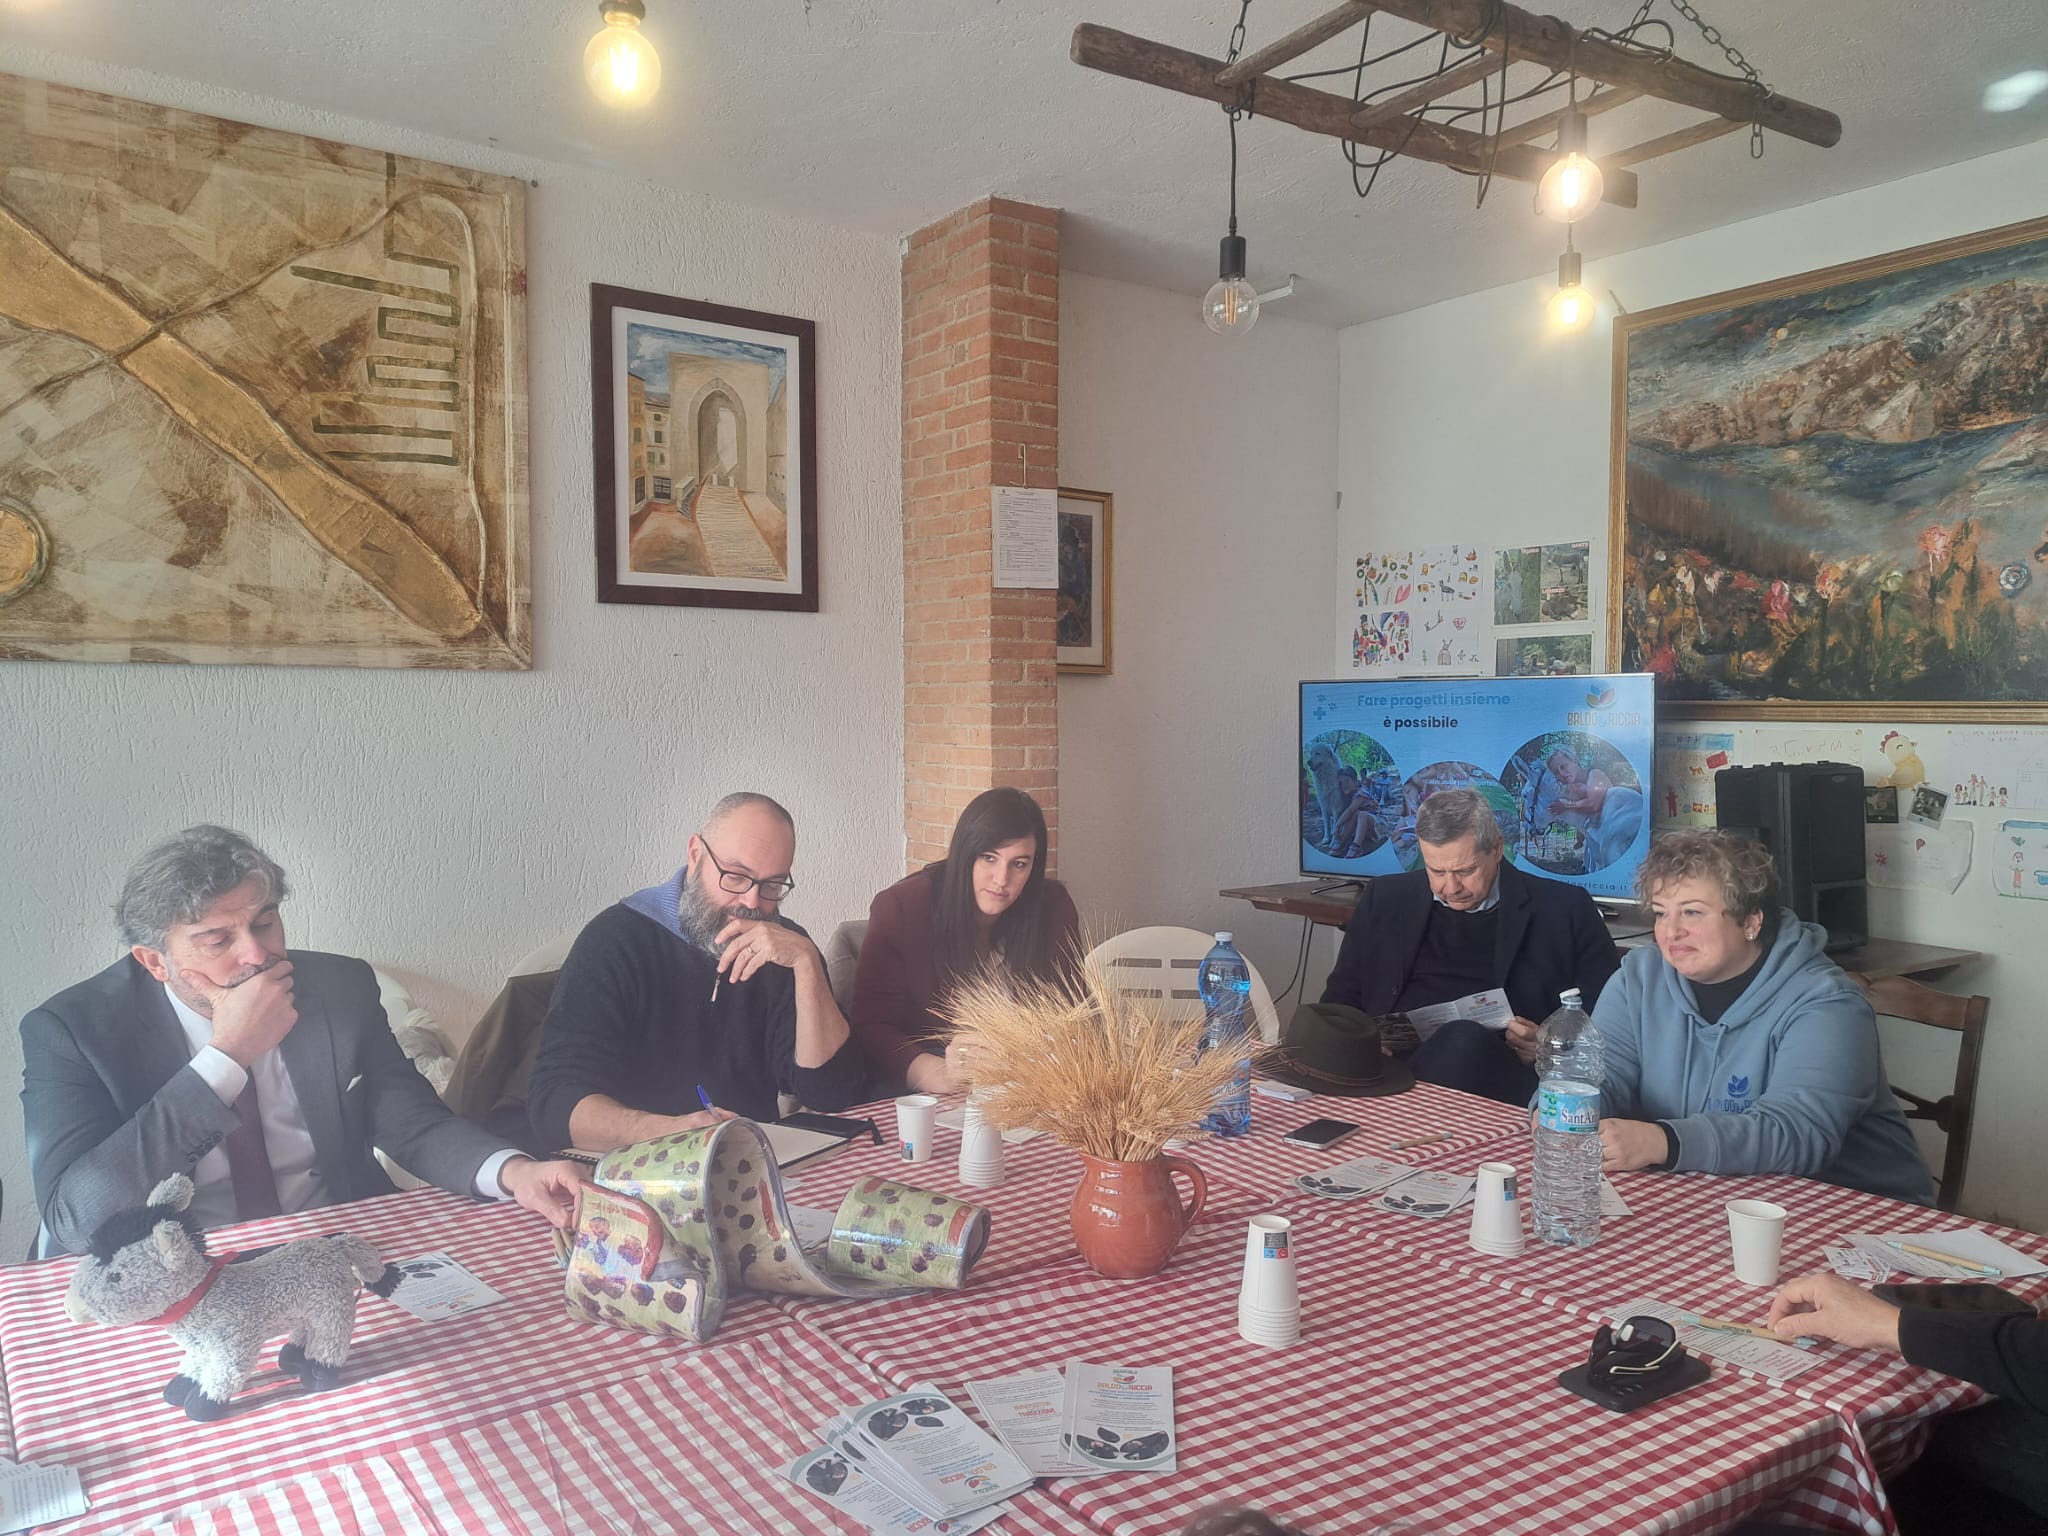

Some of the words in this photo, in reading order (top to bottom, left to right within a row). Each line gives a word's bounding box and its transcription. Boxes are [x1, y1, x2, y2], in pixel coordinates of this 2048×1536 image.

[1357, 694, 1388, 706] Fare
[1390, 693, 1447, 709] progetti
[1451, 691, 1511, 705] insieme
[1383, 715, 1392, 728] è
[1394, 715, 1458, 732] possibile
[1567, 712, 1598, 726] BALDO
[1608, 712, 1641, 727] RICCIA
